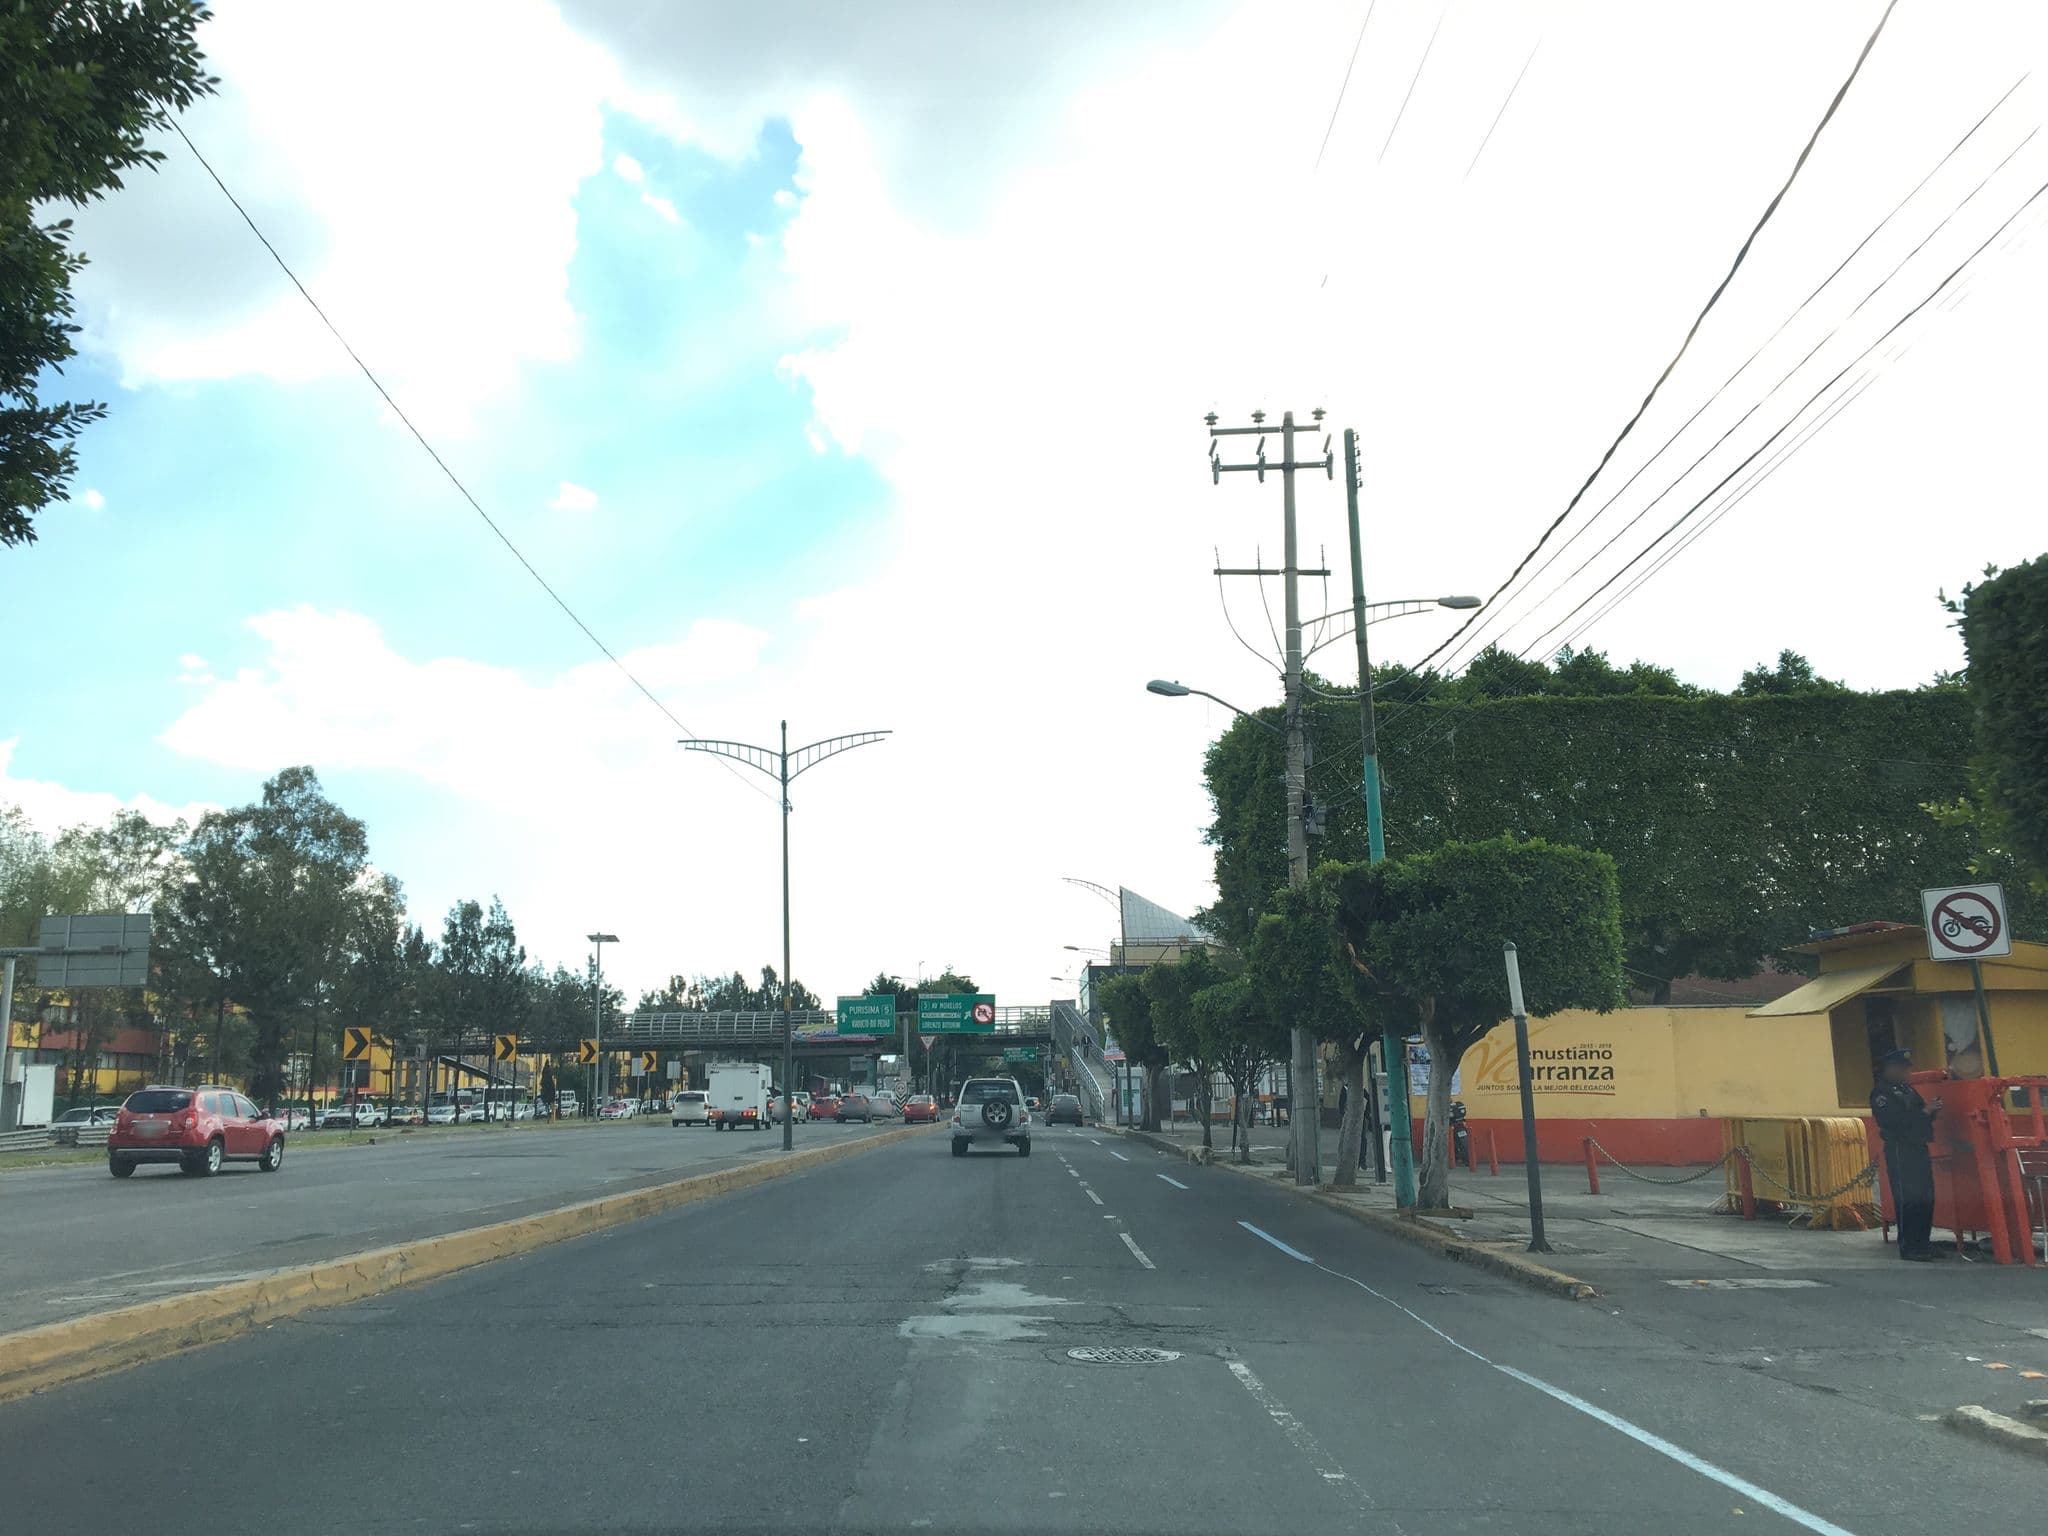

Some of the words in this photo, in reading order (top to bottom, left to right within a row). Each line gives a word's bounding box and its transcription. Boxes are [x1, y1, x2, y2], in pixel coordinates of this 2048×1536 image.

[849, 1005, 880, 1015] PURISIMA
[884, 1006, 890, 1014] 5
[1569, 1083, 1616, 1091] DELEGACIÓN
